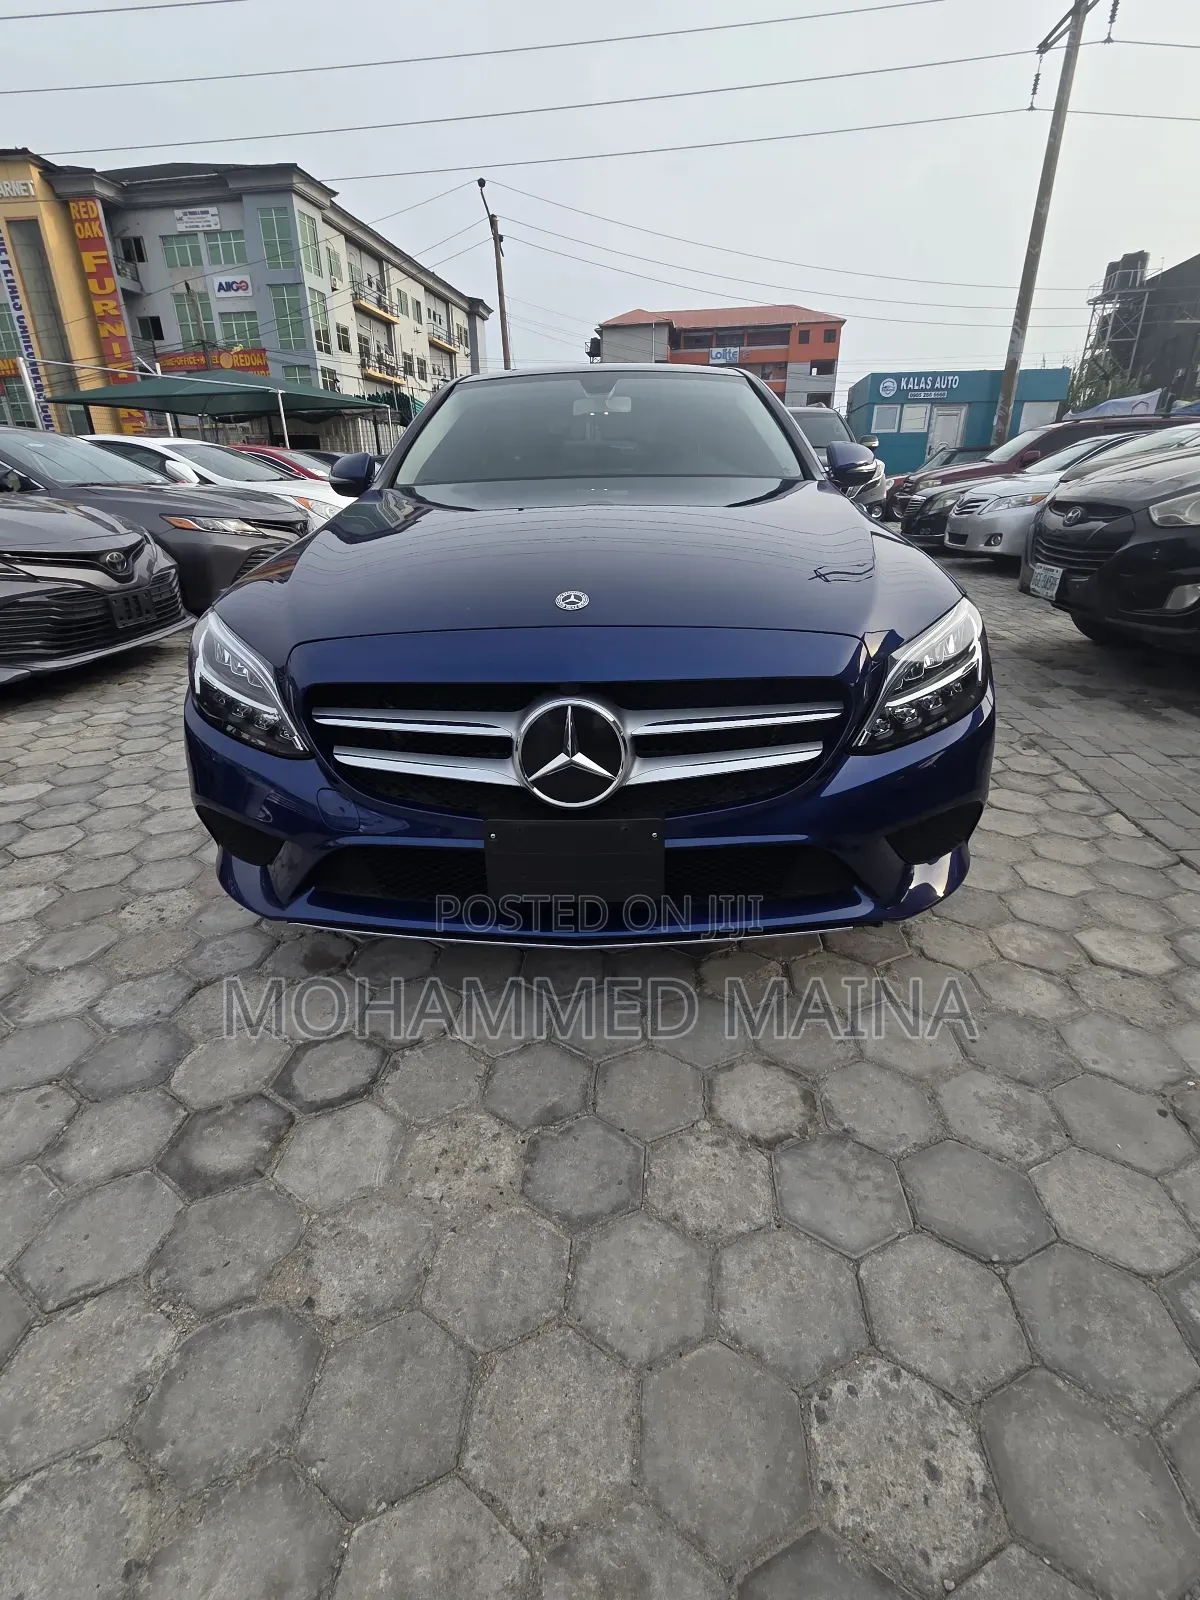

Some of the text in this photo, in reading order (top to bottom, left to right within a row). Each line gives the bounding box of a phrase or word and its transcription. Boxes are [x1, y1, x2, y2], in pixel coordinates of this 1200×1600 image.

[69, 201, 98, 219] RED
[74, 220, 104, 239] OAK
[900, 376, 932, 390] KALAS
[934, 375, 960, 389] AUTO
